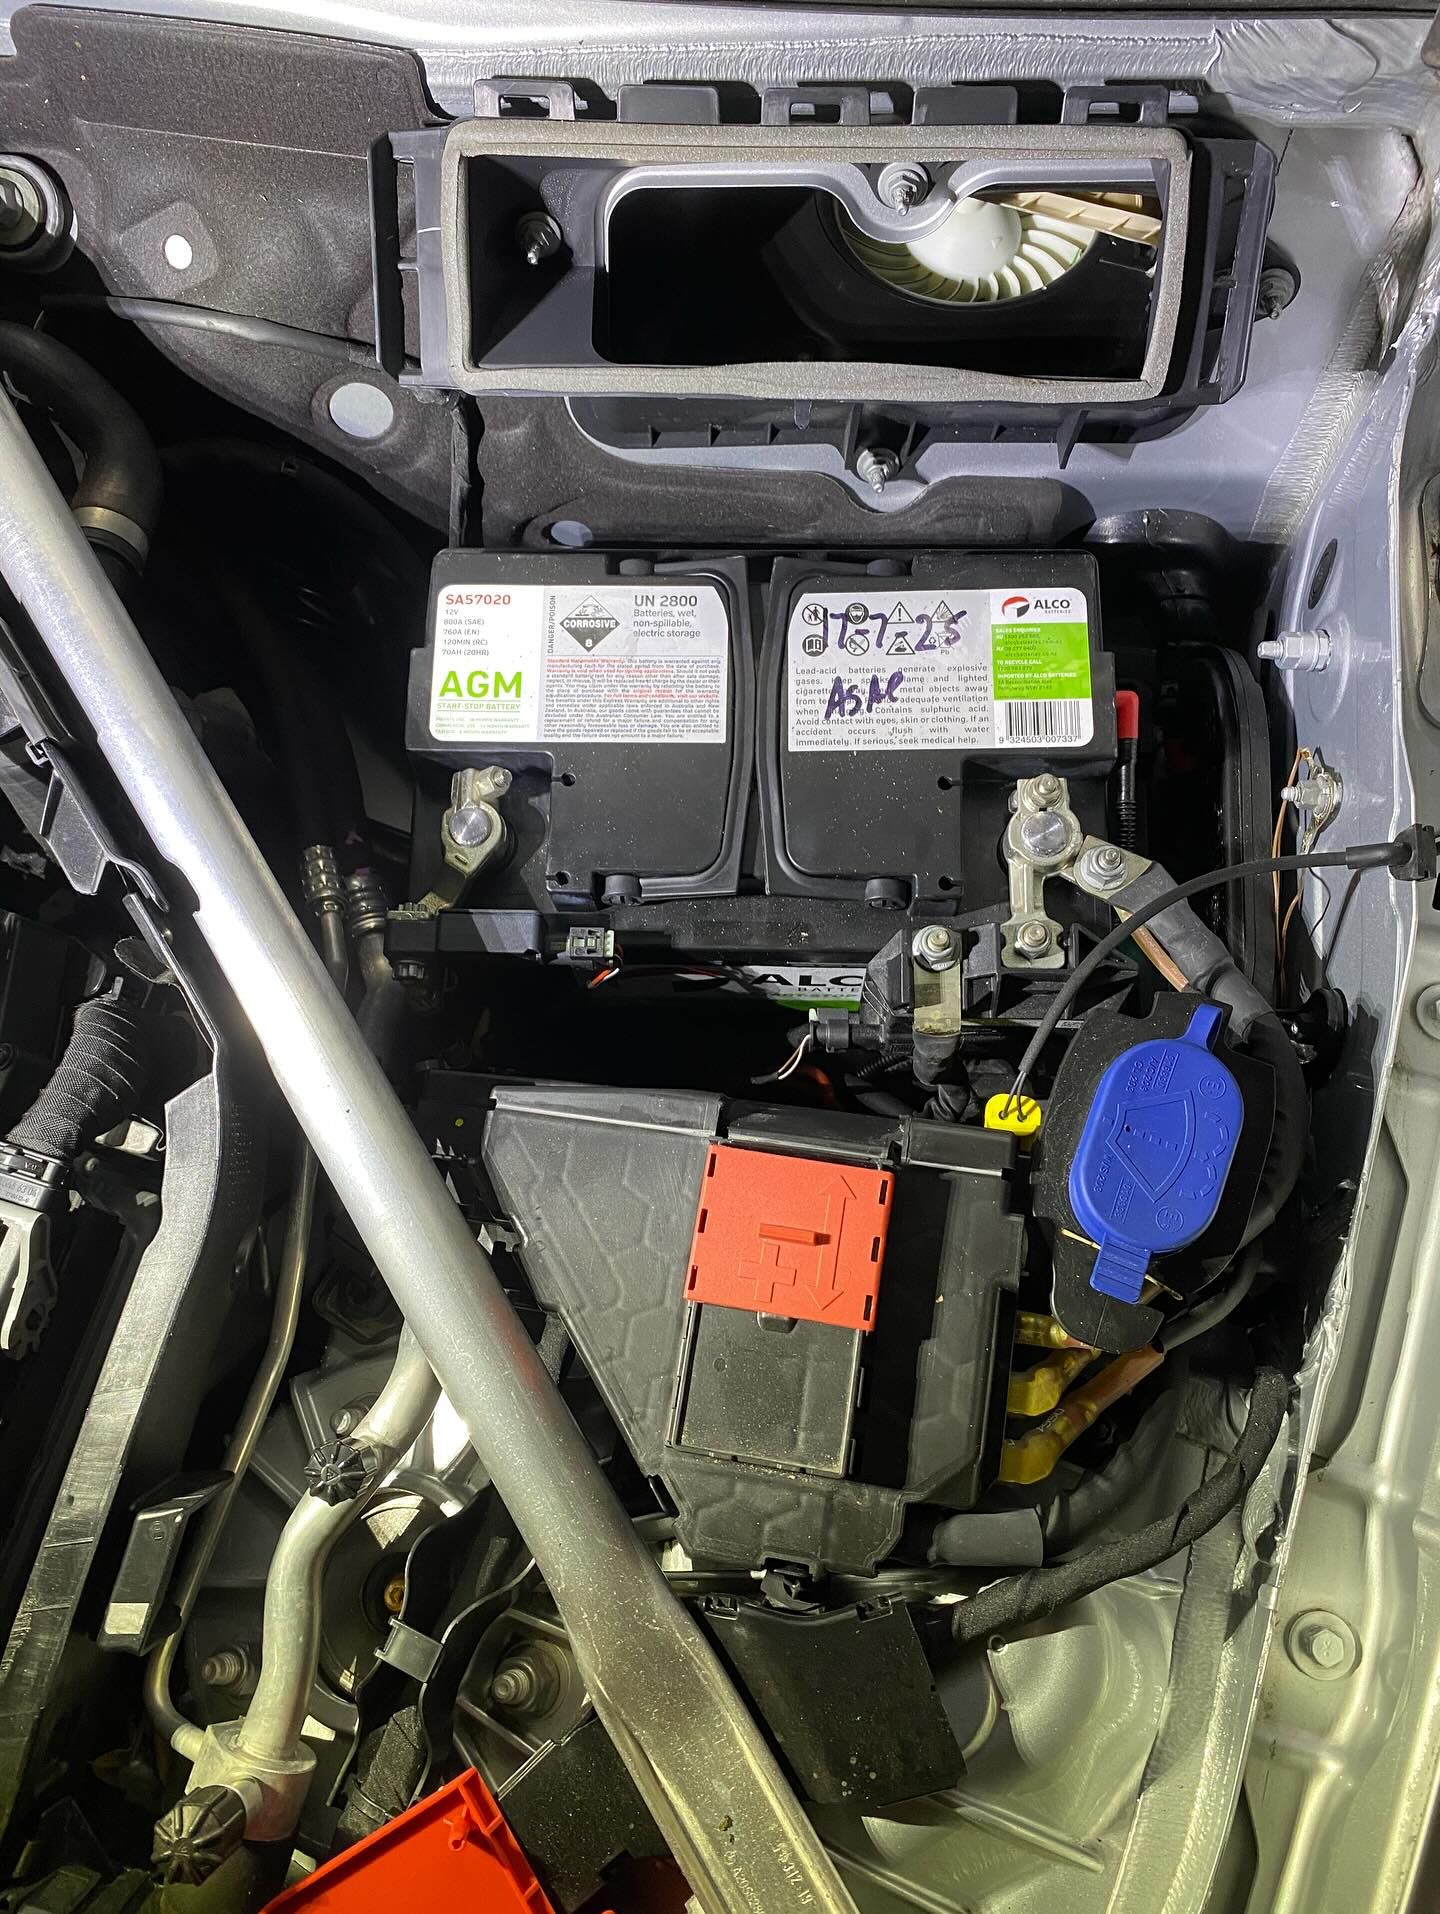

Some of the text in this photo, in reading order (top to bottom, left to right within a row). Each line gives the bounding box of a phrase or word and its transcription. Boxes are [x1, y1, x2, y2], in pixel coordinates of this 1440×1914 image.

[446, 594, 511, 605] SA57020
[634, 595, 698, 607] UN 2800
[1034, 600, 1070, 610] ALCO
[633, 610, 697, 619] Batteries, wet,
[548, 595, 556, 654] DANGER/POISON
[562, 619, 616, 628] CORROSIVE
[633, 619, 692, 629] non-spillable,
[633, 629, 701, 638] electric storage
[585, 639, 593, 648] 8
[898, 666, 935, 674] generate
[947, 664, 988, 673] explosive
[439, 670, 523, 698] AGM
[931, 716, 968, 724] clothing.
[862, 737, 896, 746] serious,
